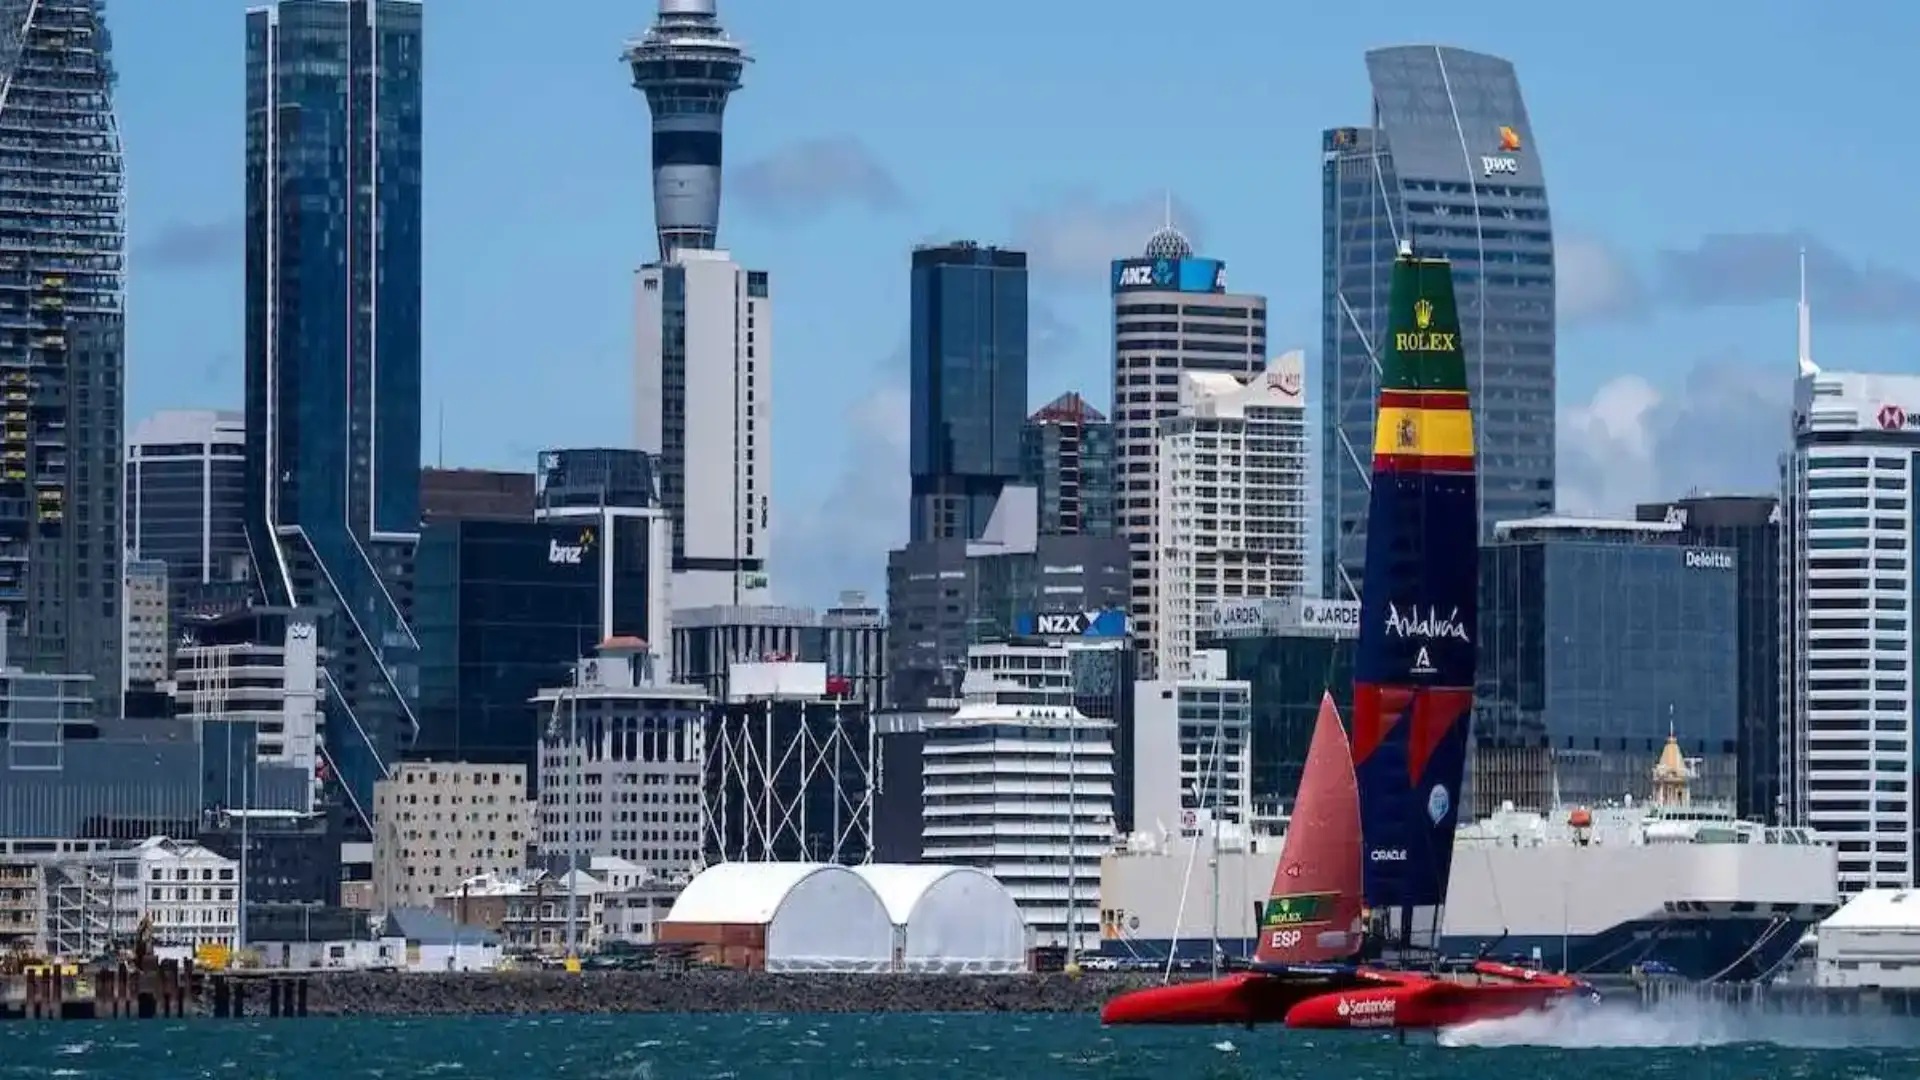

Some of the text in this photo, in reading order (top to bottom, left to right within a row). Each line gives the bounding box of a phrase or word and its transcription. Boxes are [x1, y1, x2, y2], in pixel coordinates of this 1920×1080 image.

[1481, 156, 1517, 175] pwc
[1120, 266, 1152, 286] ANZ
[1396, 333, 1456, 351] ROLEX
[549, 538, 582, 564] bnz
[1686, 551, 1731, 568] Deloitte
[1038, 613, 1081, 633] NZX
[1223, 605, 1260, 625] JARDEN
[1384, 600, 1470, 643] Andalucía
[1370, 849, 1407, 861] ORACLE
[1271, 912, 1302, 925] ROLEX
[1272, 930, 1301, 949] ESP
[1350, 997, 1396, 1016] Santander
